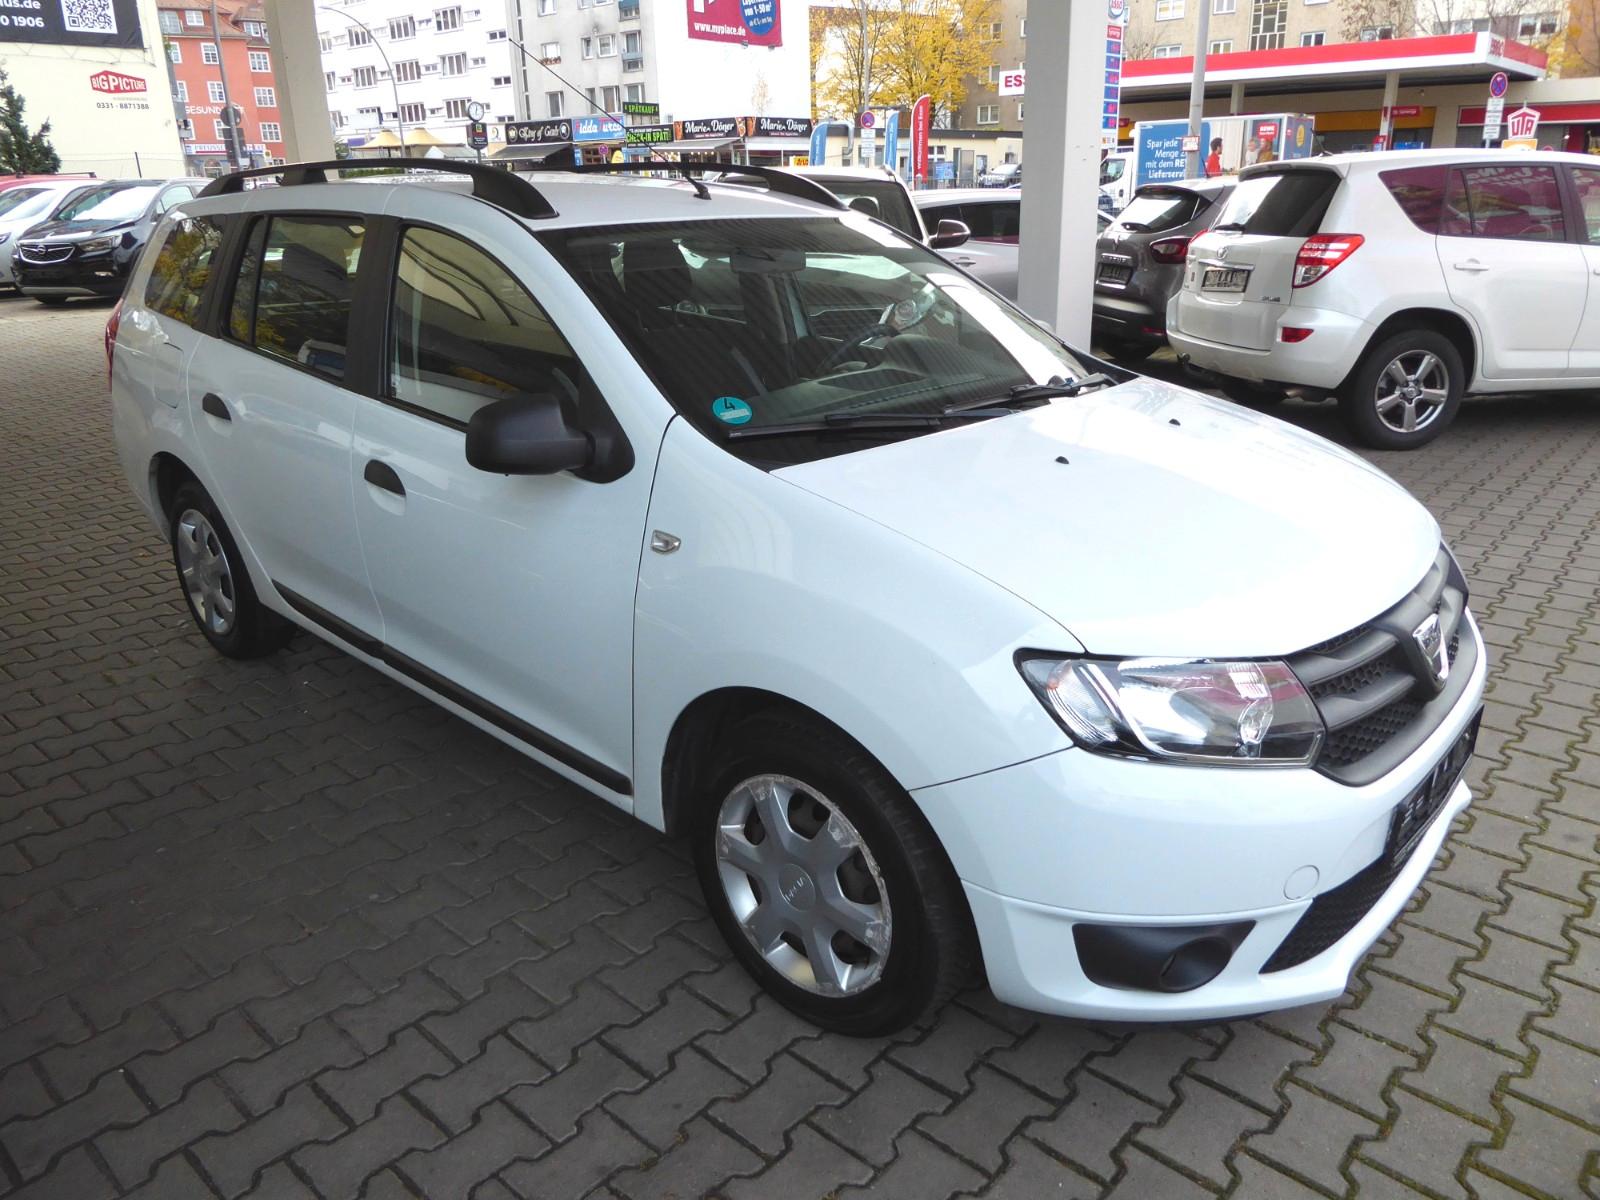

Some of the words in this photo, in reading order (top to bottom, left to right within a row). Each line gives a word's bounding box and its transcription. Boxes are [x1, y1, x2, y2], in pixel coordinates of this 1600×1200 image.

[11, 15, 45, 28] 1906
[693, 22, 746, 36] www.myplace.de
[1004, 74, 1025, 88] ES
[710, 119, 735, 132] Döner
[786, 118, 808, 131] Döner
[1511, 111, 1536, 136] UTA
[1146, 139, 1163, 150] Spar
[1163, 138, 1178, 149] jede
[1155, 149, 1179, 160] Menge
[1145, 159, 1157, 168] mit
[1158, 159, 1174, 168] dem
[1174, 158, 1185, 168] RE
[723, 397, 736, 410] 4
